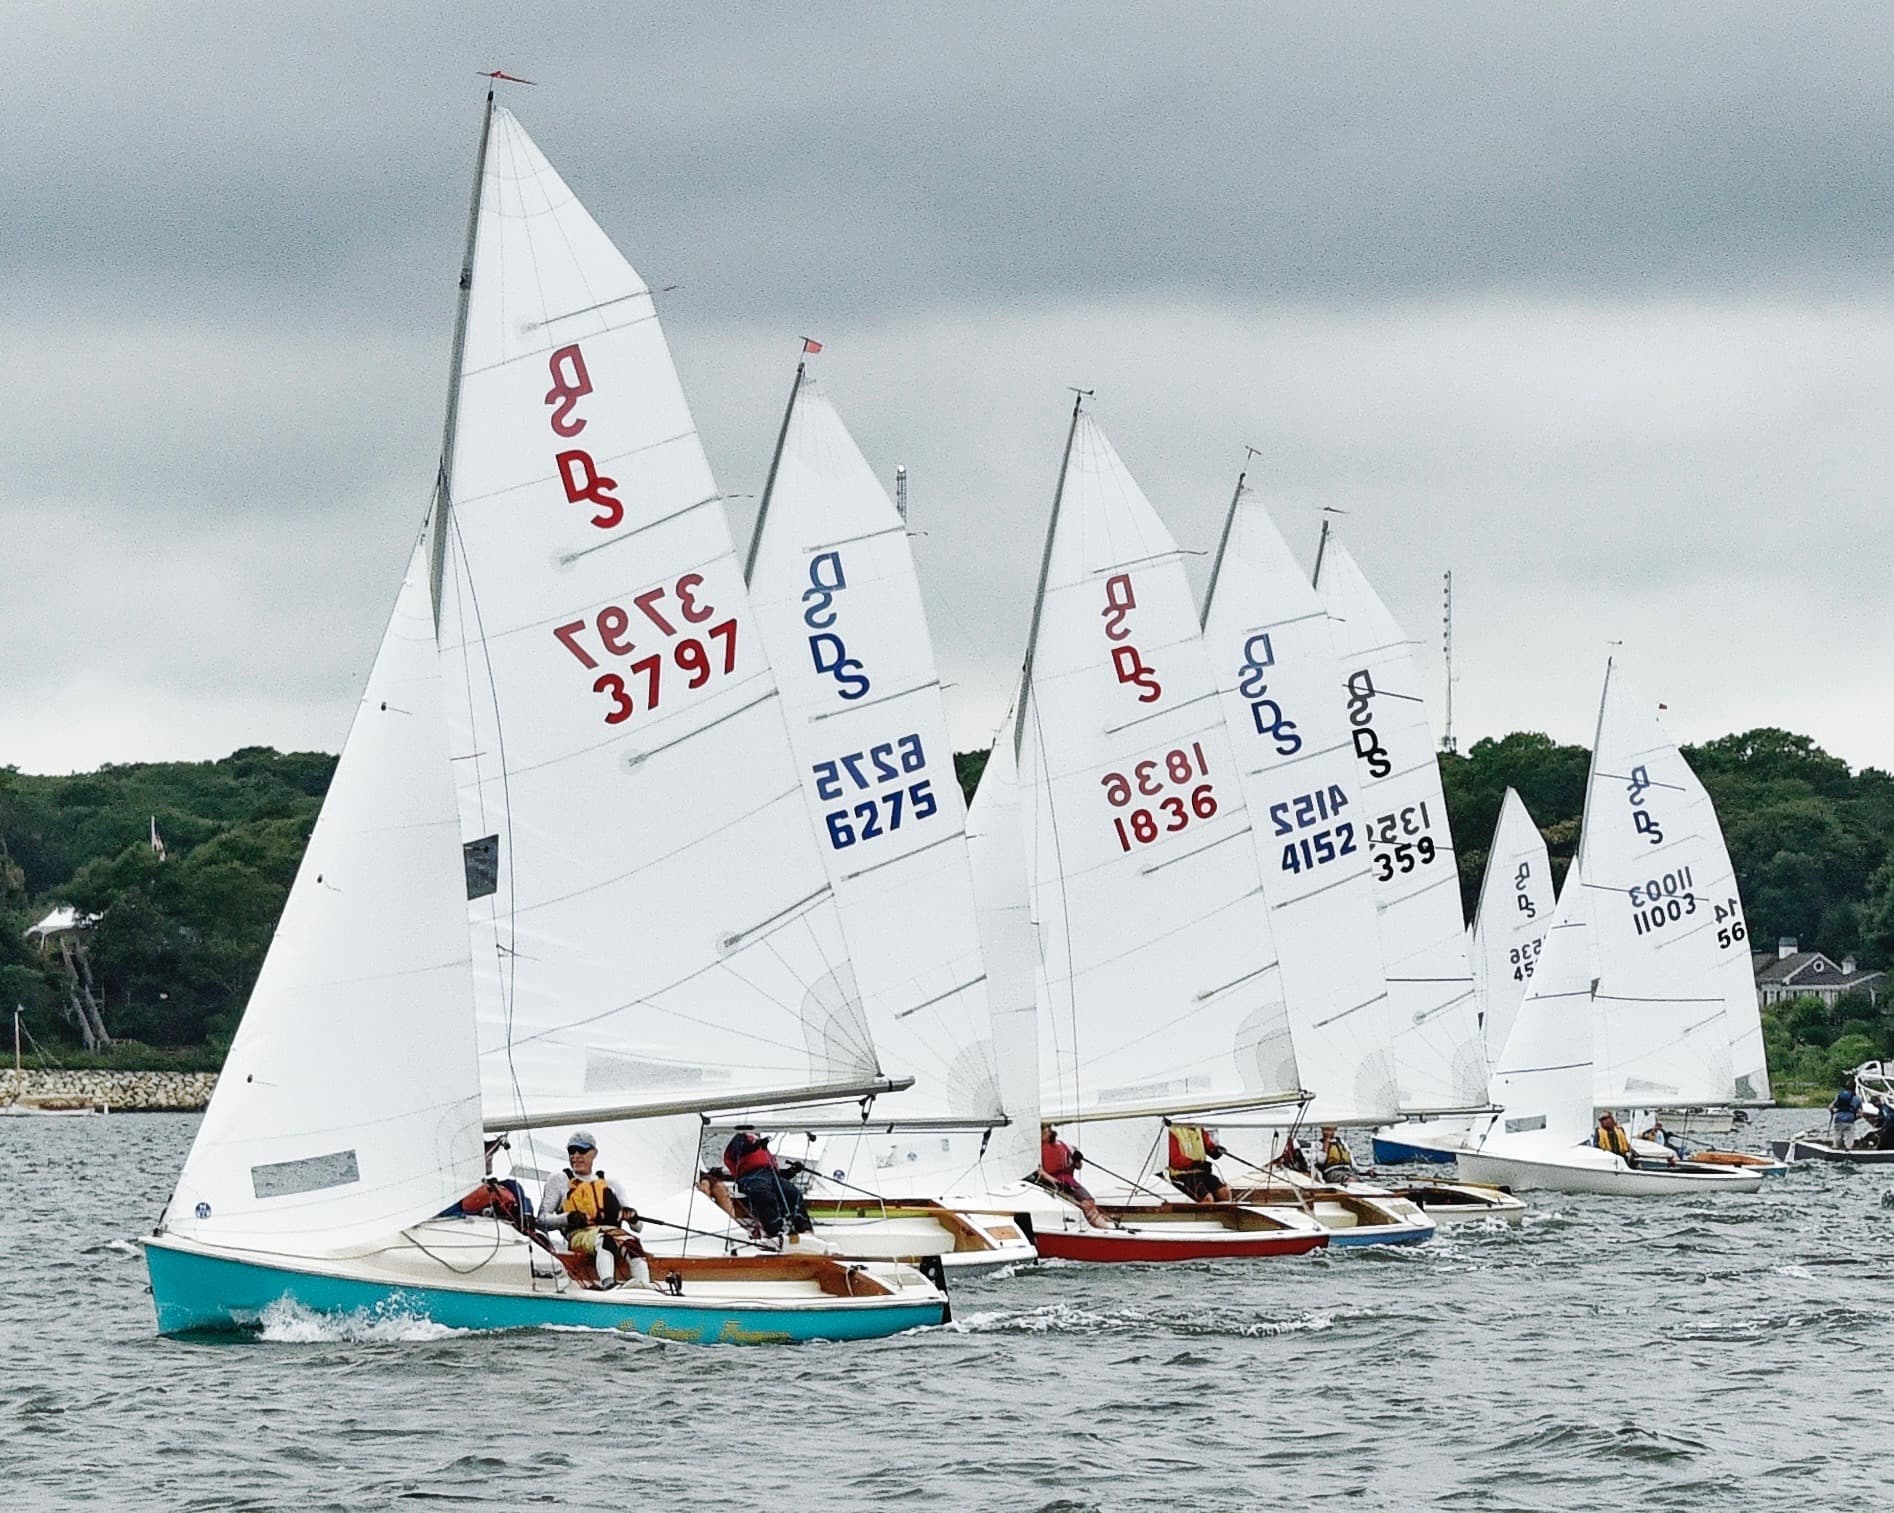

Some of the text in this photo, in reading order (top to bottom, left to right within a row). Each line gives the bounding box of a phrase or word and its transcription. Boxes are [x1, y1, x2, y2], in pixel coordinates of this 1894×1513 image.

[555, 449, 624, 529] DS
[593, 618, 737, 724] 3797
[808, 632, 870, 700] DS
[1111, 645, 1161, 703] DS
[1251, 699, 1302, 755] DS
[1352, 727, 1391, 778] DS
[825, 779, 937, 850] 6275
[1114, 784, 1217, 852] 1836
[1633, 810, 1663, 844] DS
[1282, 822, 1357, 874] 4152
[1517, 894, 1536, 918] DS
[1633, 892, 1696, 935] 11003
[1718, 921, 1745, 949] 56
[1513, 959, 1538, 981] 45
